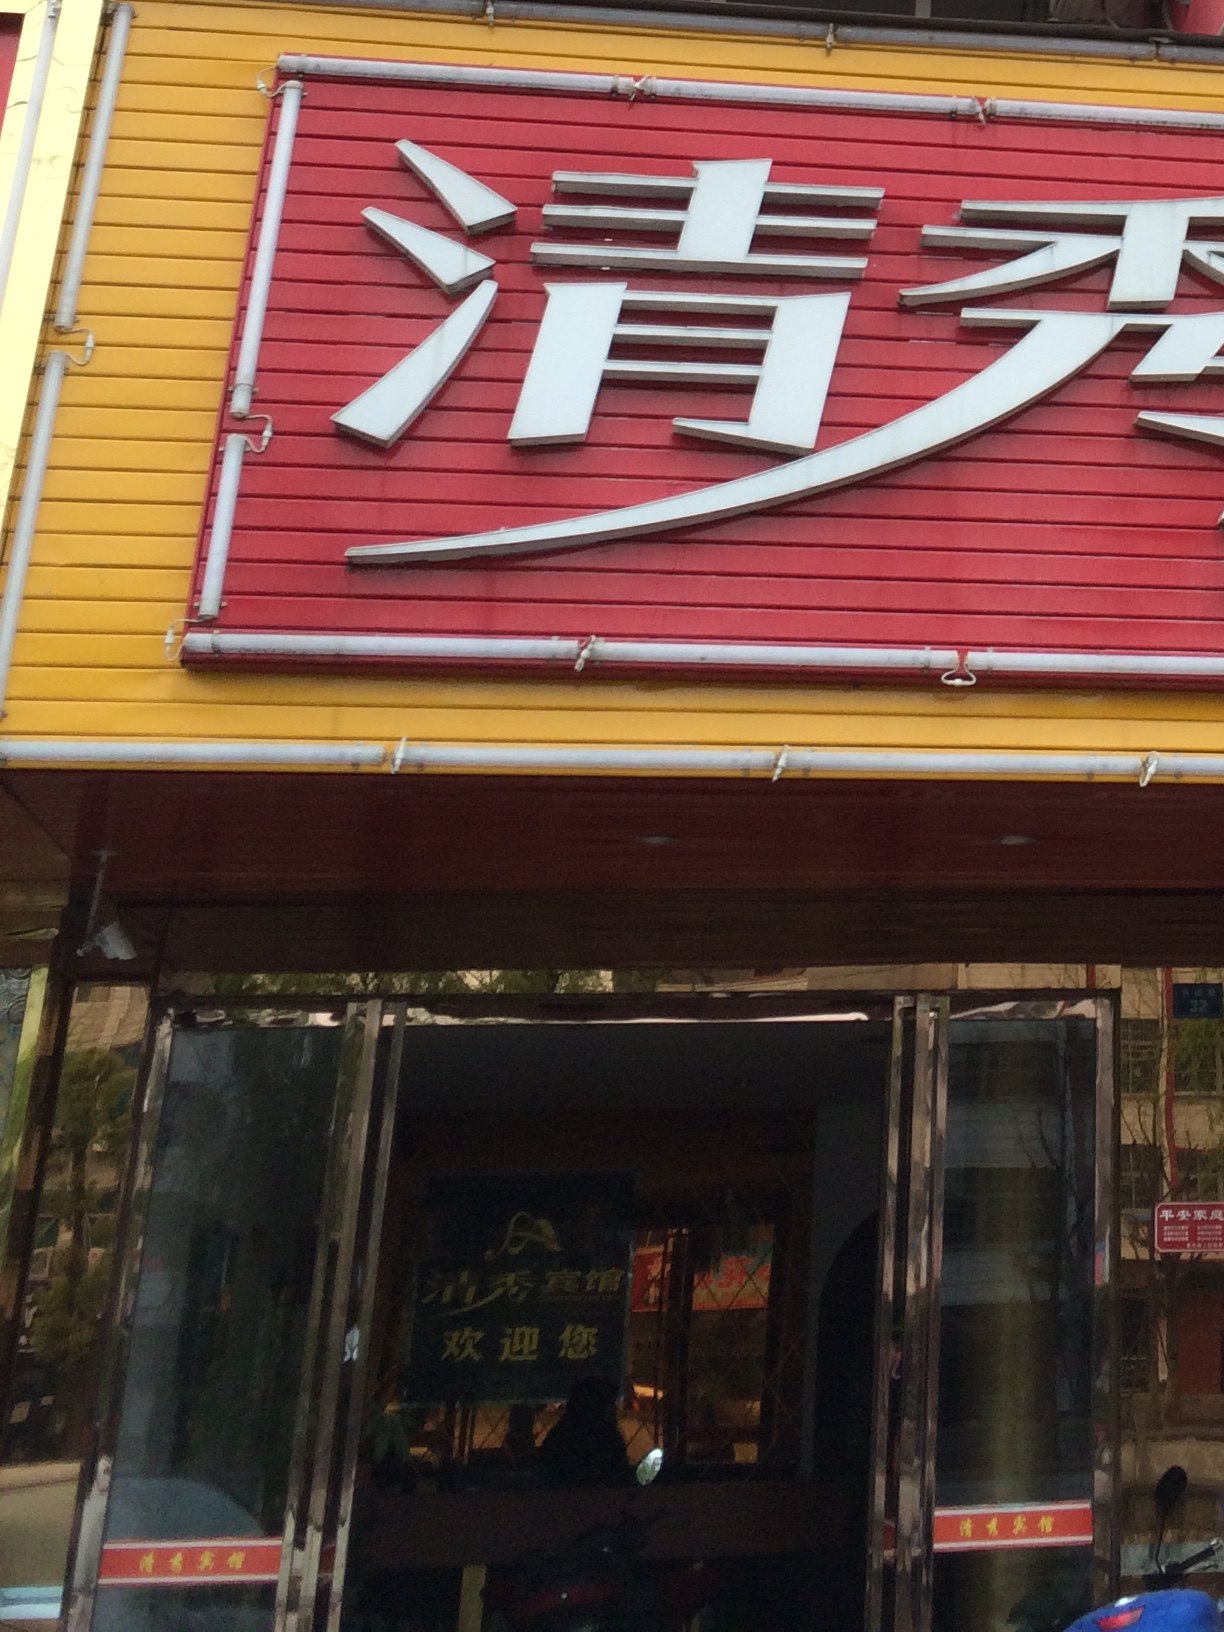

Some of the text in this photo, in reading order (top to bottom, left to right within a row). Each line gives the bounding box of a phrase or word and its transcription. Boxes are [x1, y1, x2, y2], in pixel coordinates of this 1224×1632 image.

[1159, 1208, 1224, 1221] 平安家庭
[440, 1324, 600, 1364] 欢迎您
[959, 1515, 1055, 1537] 清秀宾馆
[138, 1550, 246, 1573] 清秀宾馆
